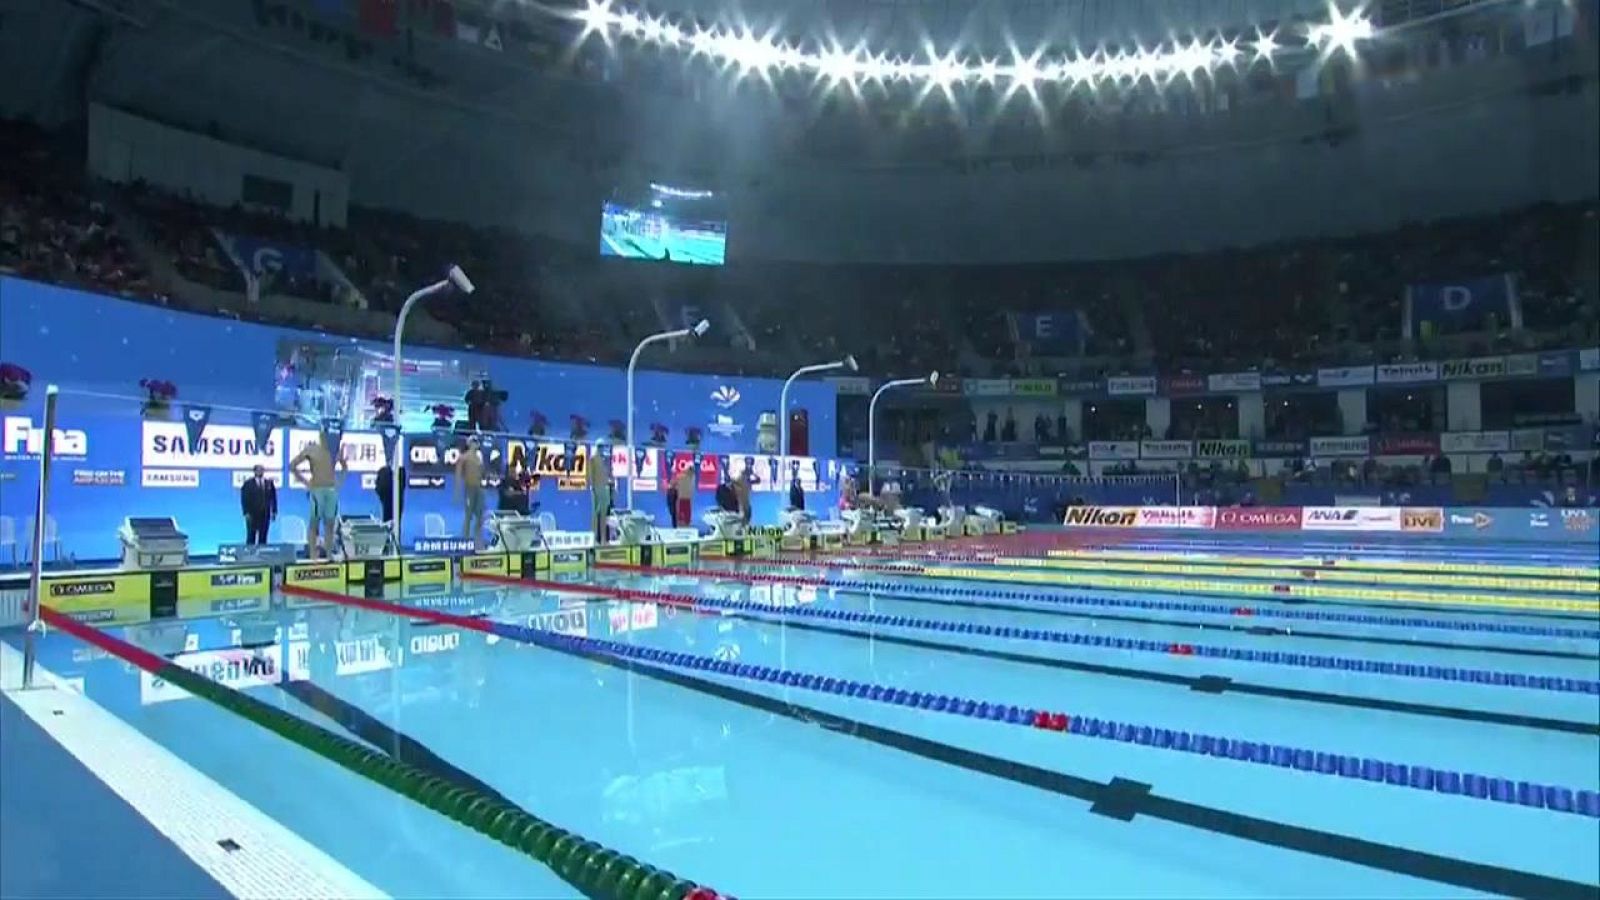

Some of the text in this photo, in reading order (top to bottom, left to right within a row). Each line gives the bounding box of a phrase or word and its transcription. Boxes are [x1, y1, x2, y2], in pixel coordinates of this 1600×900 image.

[1443, 286, 1471, 311] D
[1036, 314, 1053, 338] E
[1066, 507, 1137, 525] Nikon
[1239, 513, 1297, 525] OMEGA
[415, 541, 475, 551] SAMSUNG
